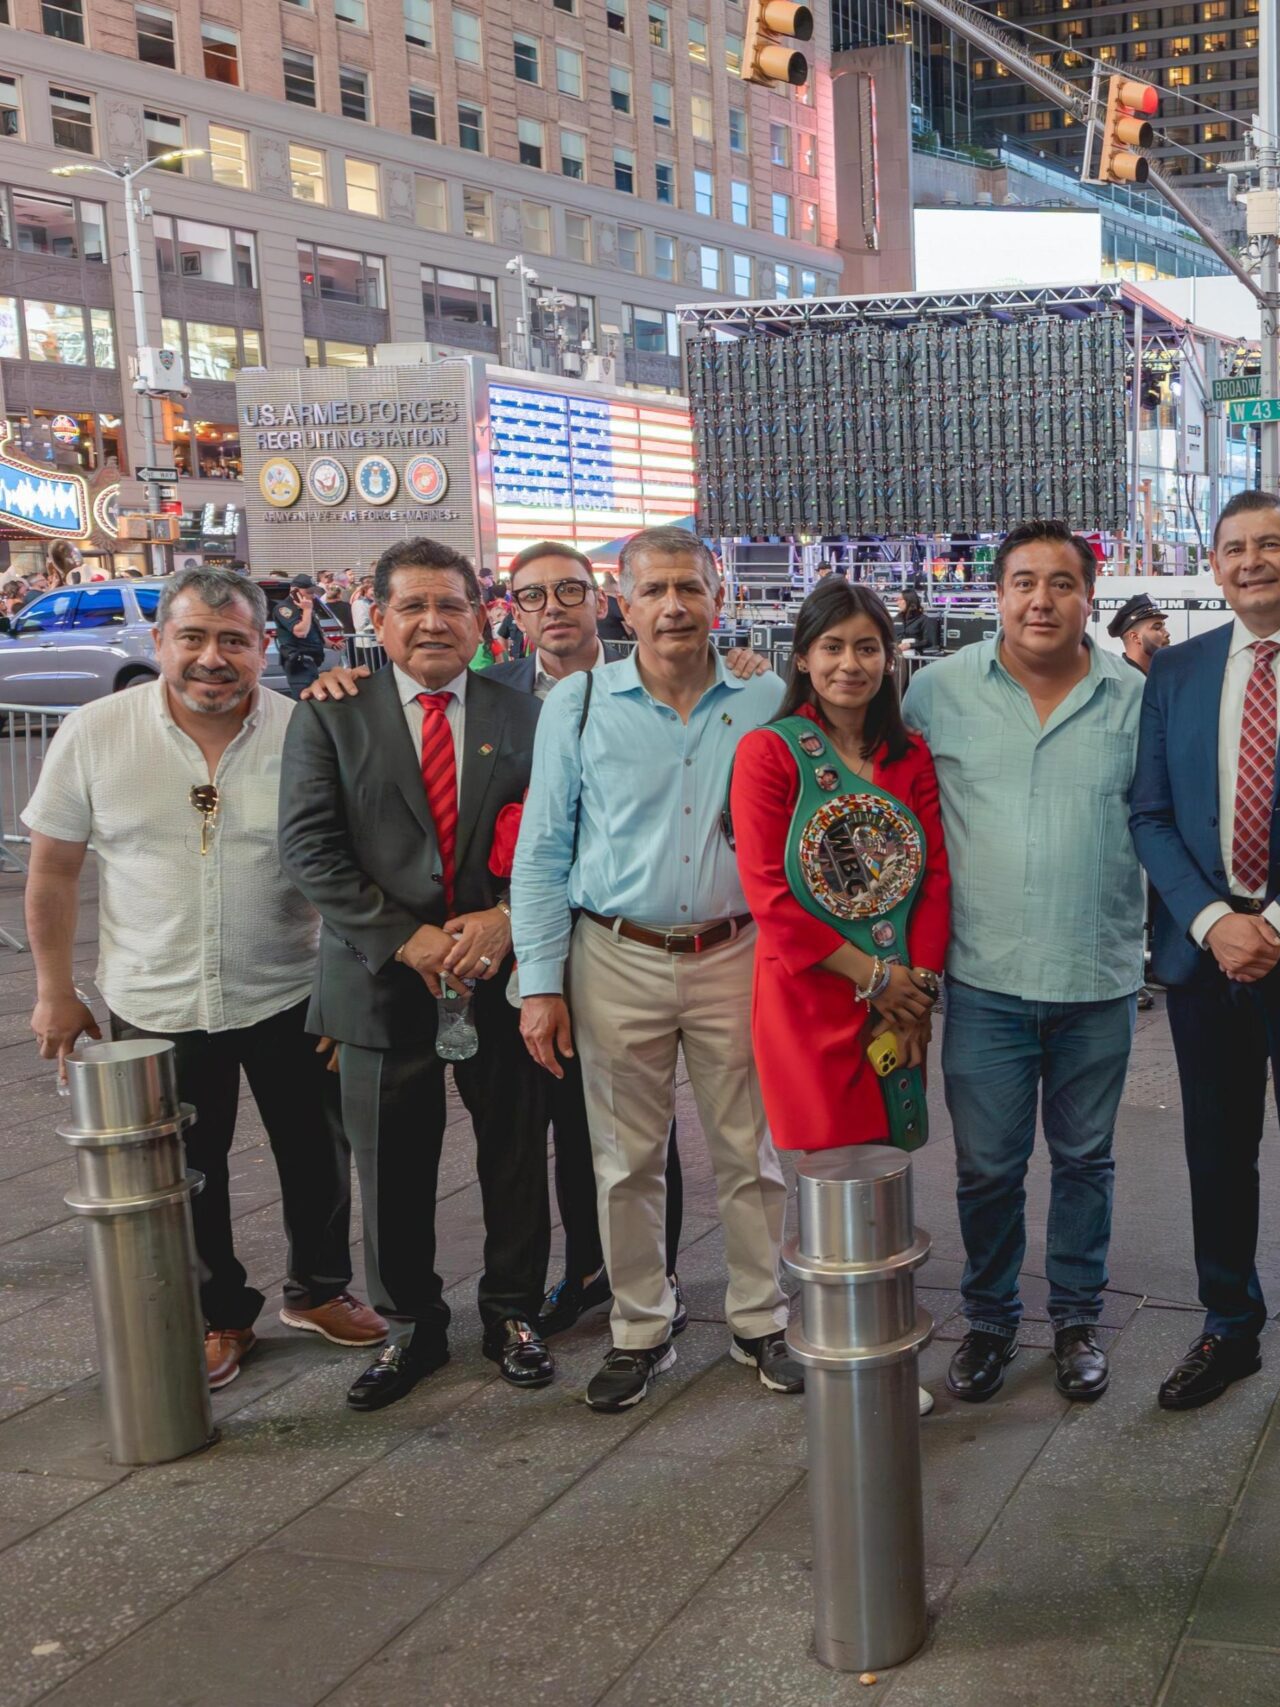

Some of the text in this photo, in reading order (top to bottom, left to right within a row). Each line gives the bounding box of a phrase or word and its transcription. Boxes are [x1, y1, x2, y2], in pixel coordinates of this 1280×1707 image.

[1215, 378, 1261, 399] BROADWA
[282, 401, 364, 425] ARMED
[366, 399, 459, 423] FORCES
[1233, 403, 1246, 421] W
[1252, 401, 1272, 419] 43
[256, 427, 448, 449] RECRUITING STATION
[1198, 600, 1217, 610] 70
